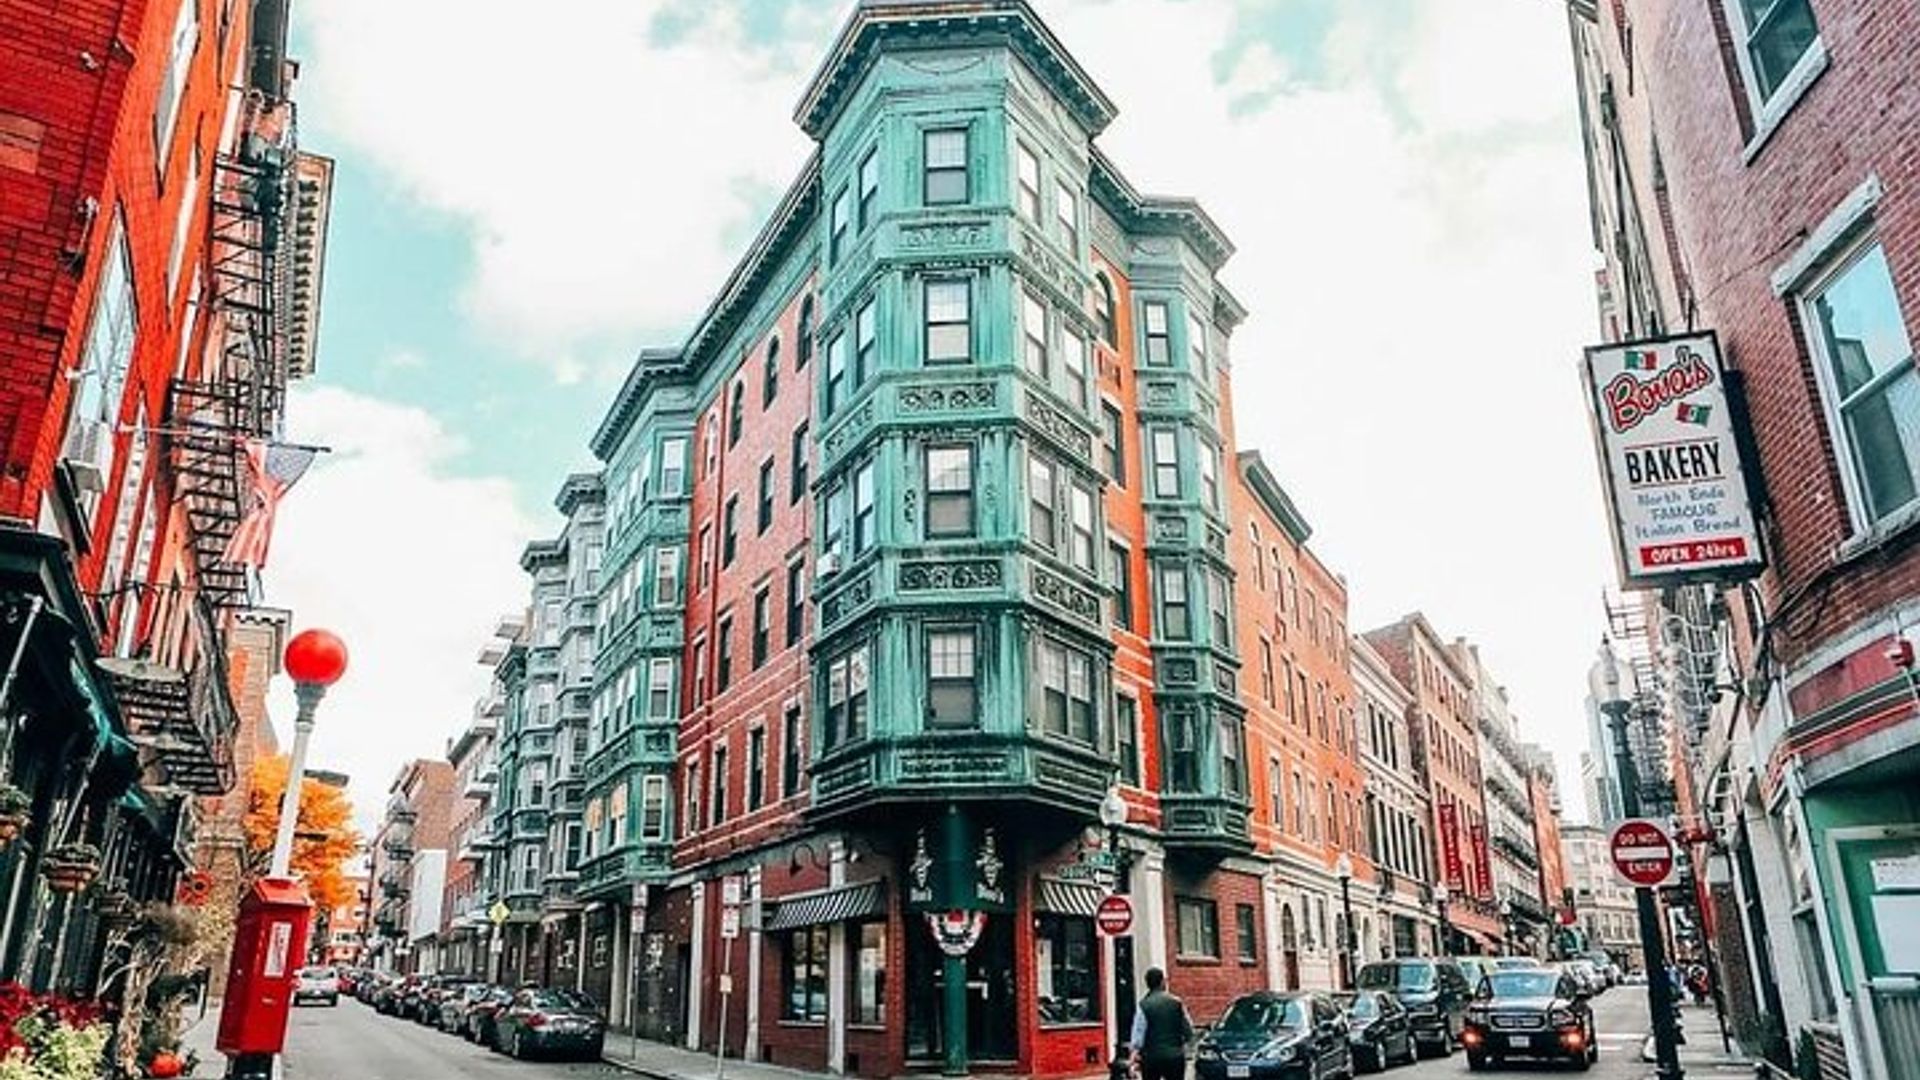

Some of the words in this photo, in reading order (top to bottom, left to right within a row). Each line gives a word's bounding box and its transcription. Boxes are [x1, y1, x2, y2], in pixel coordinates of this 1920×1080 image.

[1603, 346, 1714, 434] Bova's
[1624, 441, 1721, 484] BAKERY
[1637, 490, 1681, 506] North
[1634, 524, 1685, 538] Italian
[1692, 516, 1741, 533] Bread
[1651, 546, 1691, 563] OPEN
[1696, 543, 1738, 560] 24hrs
[1619, 833, 1636, 846] DO
[1638, 831, 1660, 845] NOT
[1627, 862, 1662, 875] ENTER
